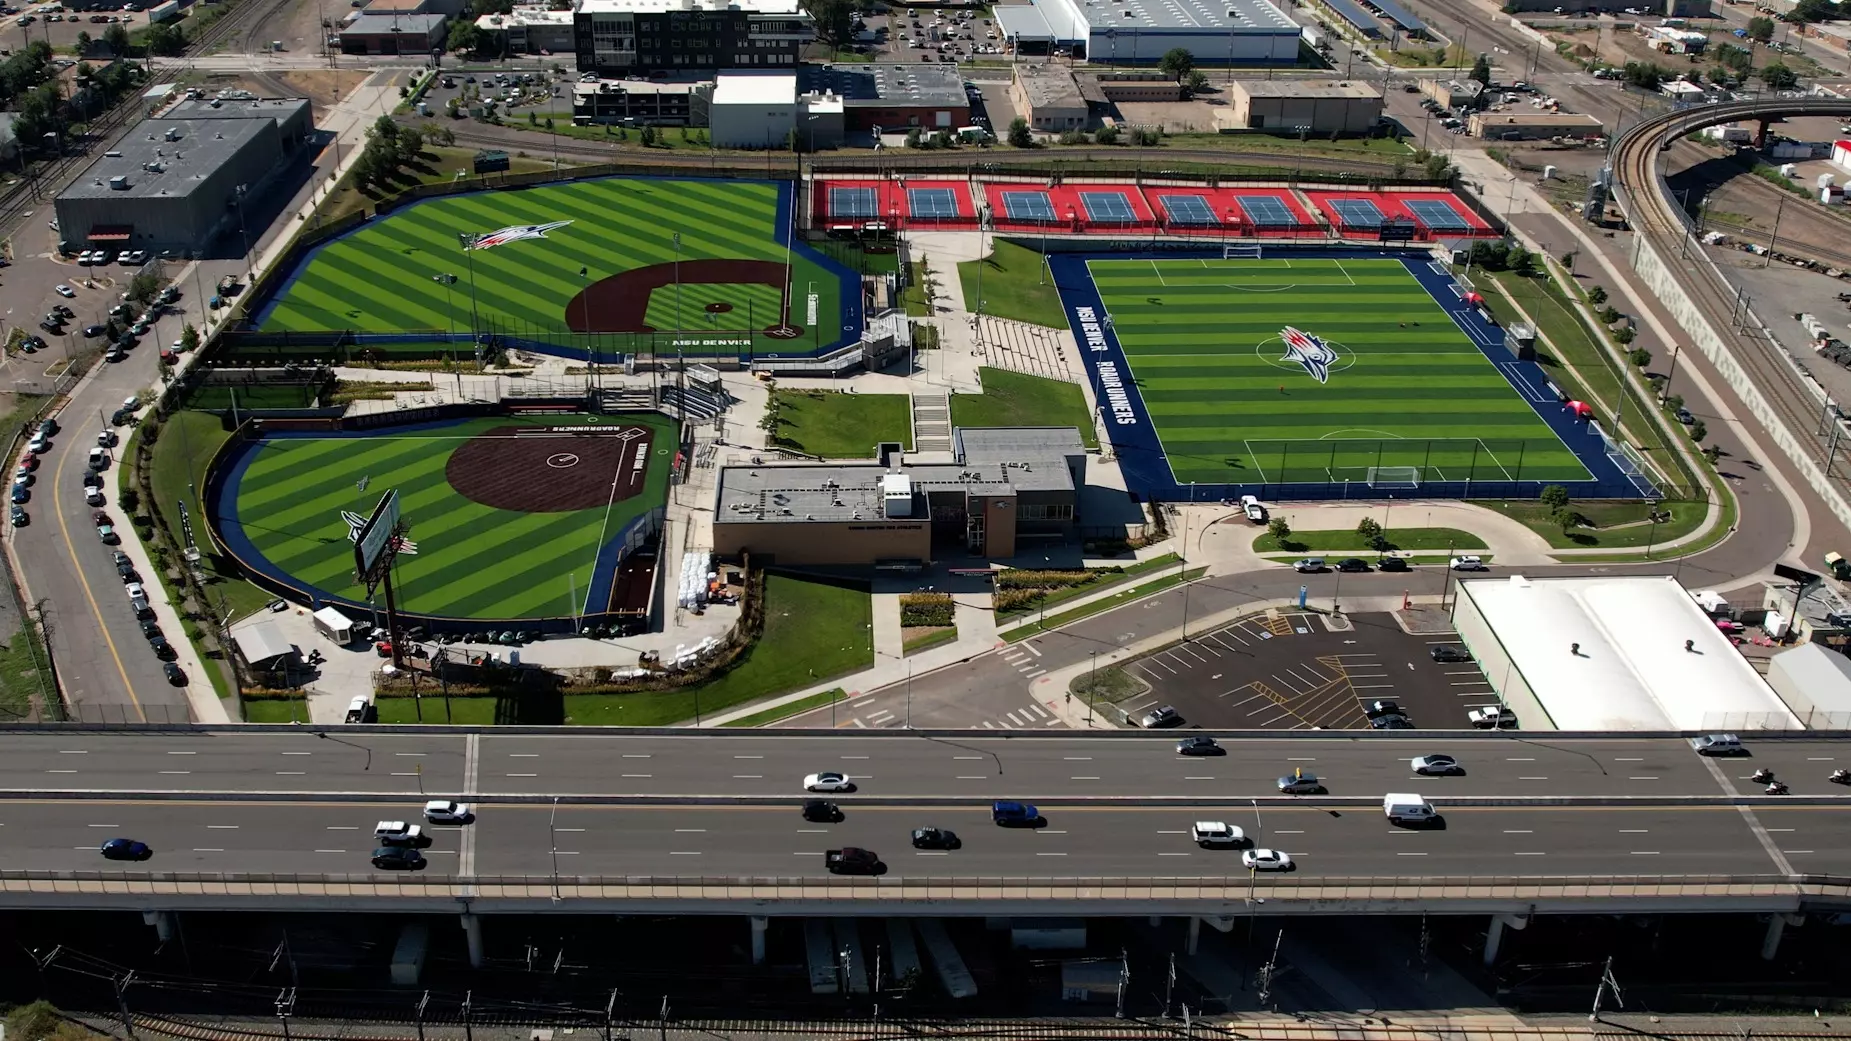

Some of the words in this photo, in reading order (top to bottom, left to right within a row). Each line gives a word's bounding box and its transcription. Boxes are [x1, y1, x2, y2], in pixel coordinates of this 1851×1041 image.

[1076, 306, 1097, 322] MSU
[1082, 323, 1108, 352] DENVER
[1096, 361, 1137, 425] ROADRUNNERS
